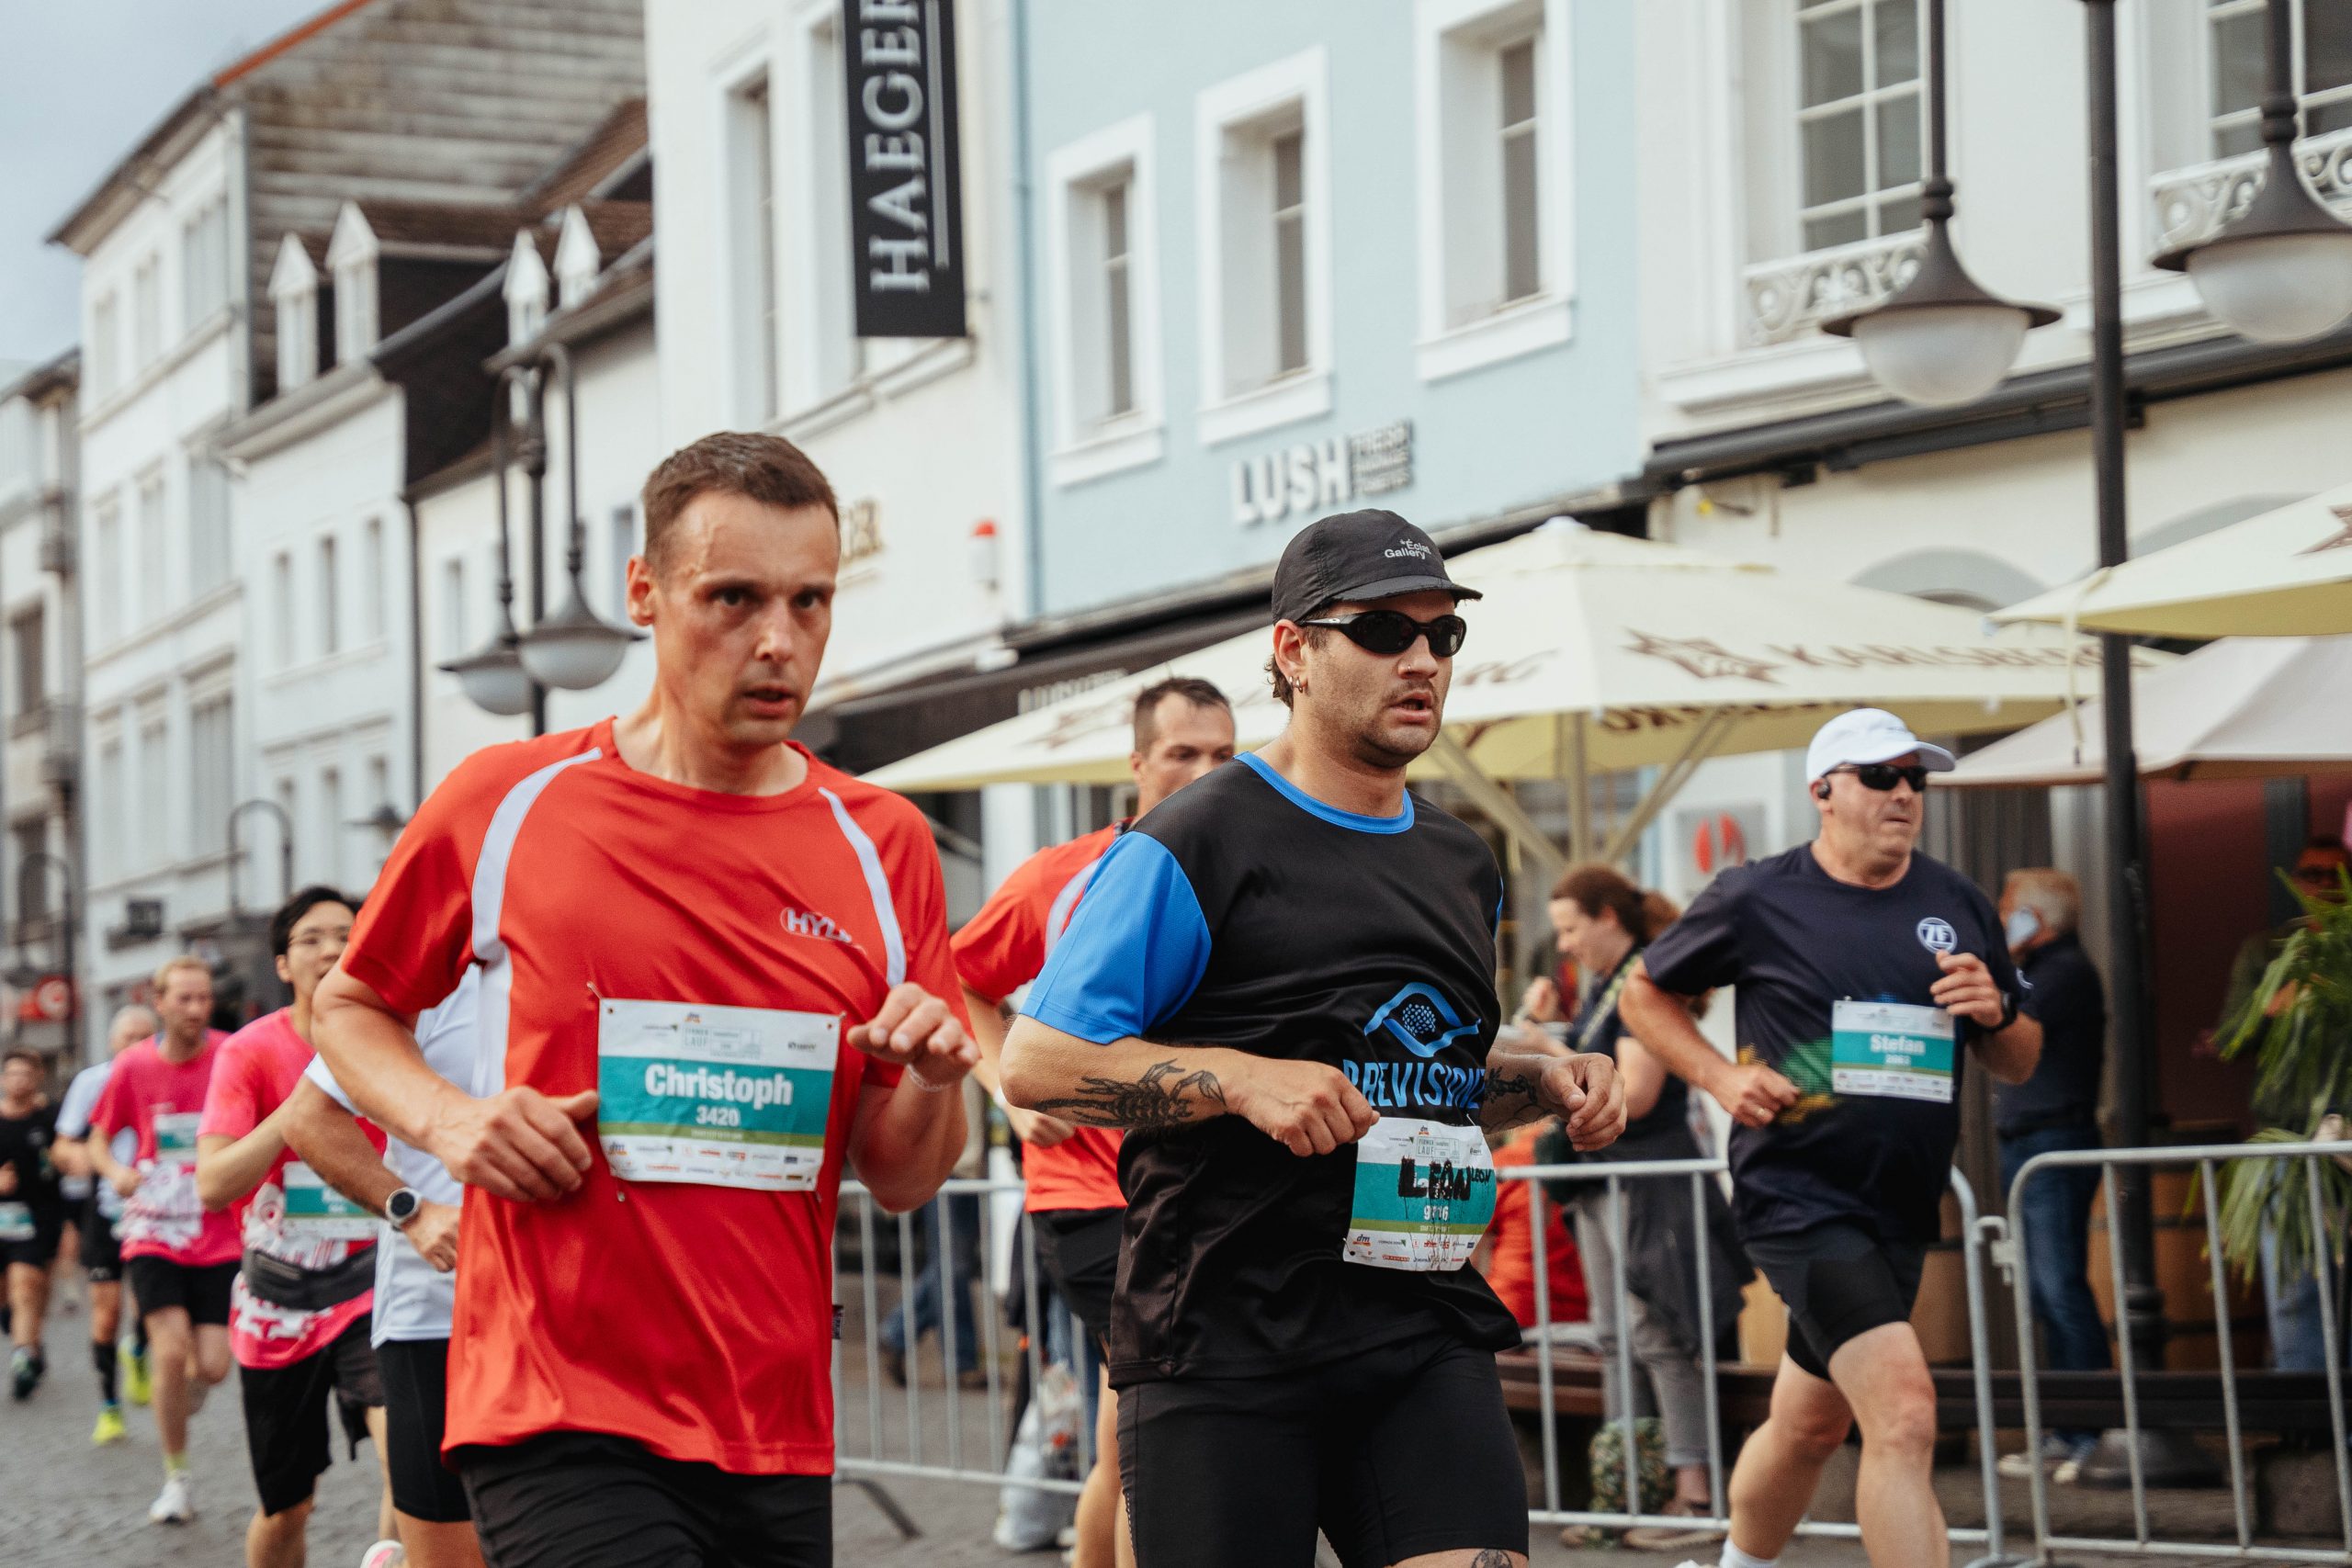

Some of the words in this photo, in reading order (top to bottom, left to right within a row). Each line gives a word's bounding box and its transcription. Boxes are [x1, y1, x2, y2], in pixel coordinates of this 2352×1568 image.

[1233, 434, 1351, 525] LUSH
[1385, 547, 1426, 559] Gallery
[1871, 1034, 1927, 1056] Stefan
[645, 1062, 794, 1111] Christoph
